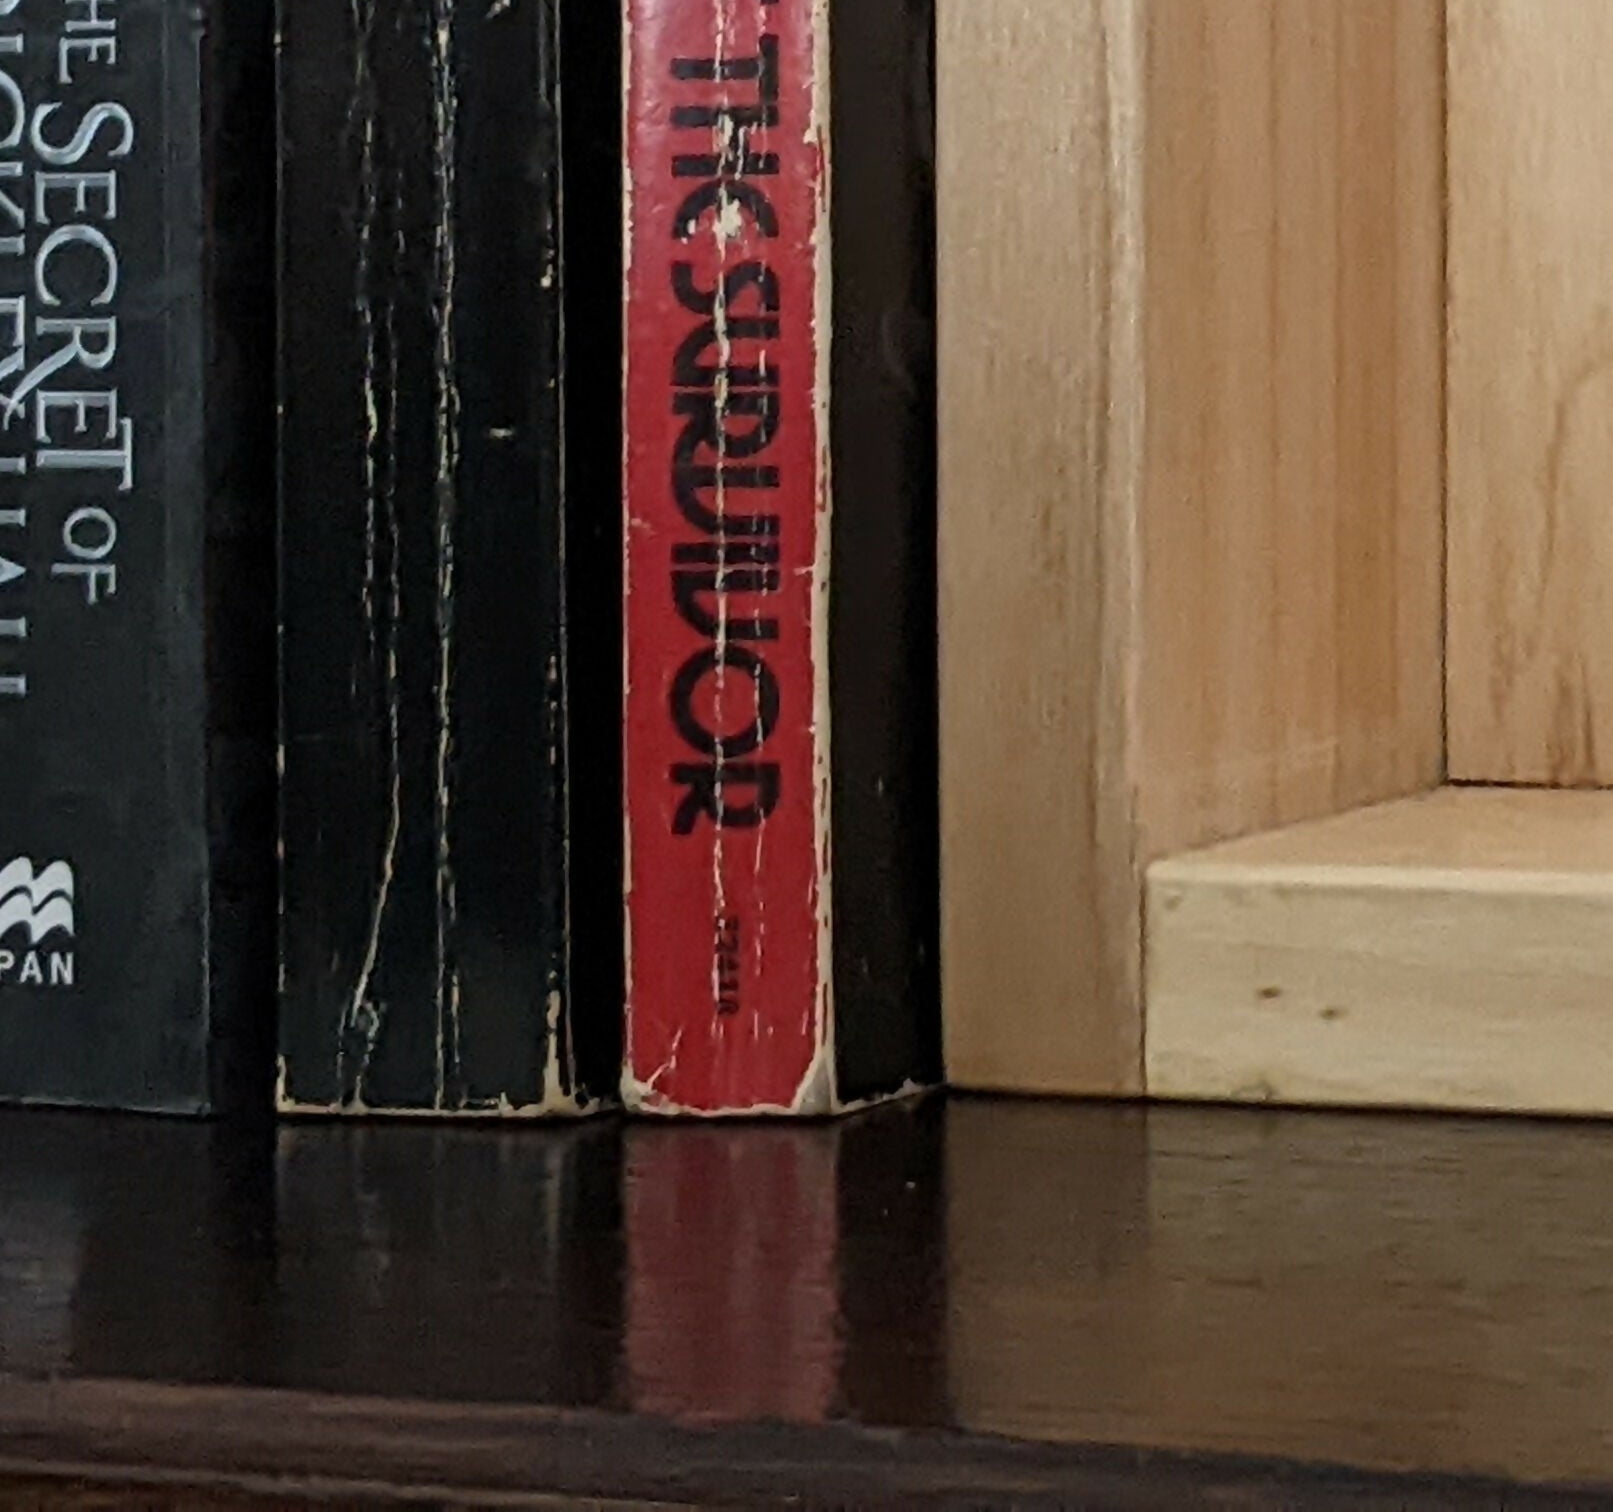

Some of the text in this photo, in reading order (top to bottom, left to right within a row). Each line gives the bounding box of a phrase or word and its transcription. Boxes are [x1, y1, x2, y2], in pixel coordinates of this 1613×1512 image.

[669, 32, 781, 243] THE
[2, 101, 134, 491] SECRET
[50, 505, 117, 605] OF
